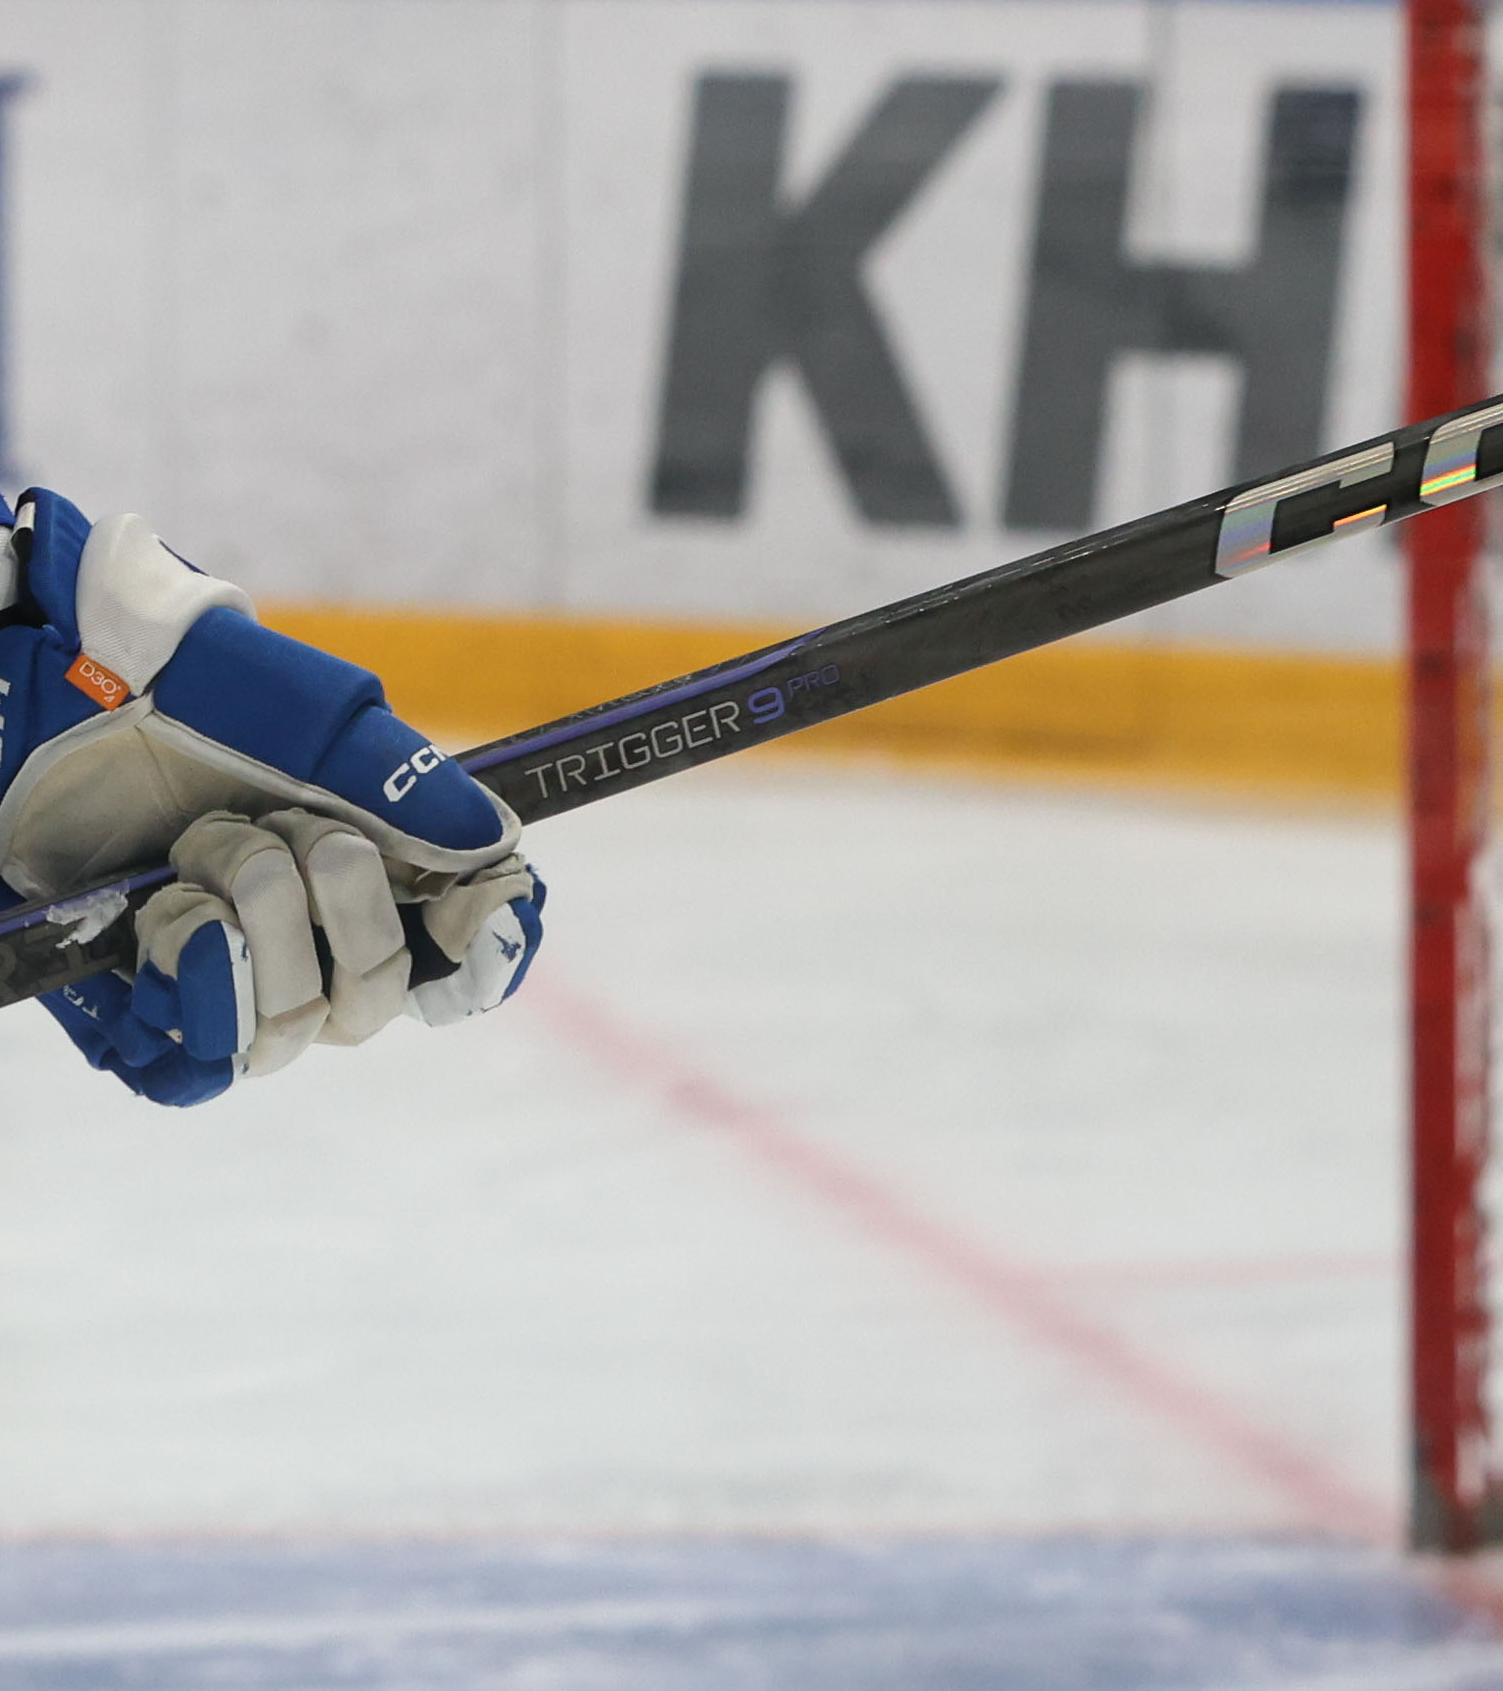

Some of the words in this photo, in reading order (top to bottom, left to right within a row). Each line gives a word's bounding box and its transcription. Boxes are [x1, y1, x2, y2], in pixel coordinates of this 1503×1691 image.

[524, 700, 742, 799] TRIGGER
[748, 686, 786, 725] 9
[786, 663, 841, 699] PRO
